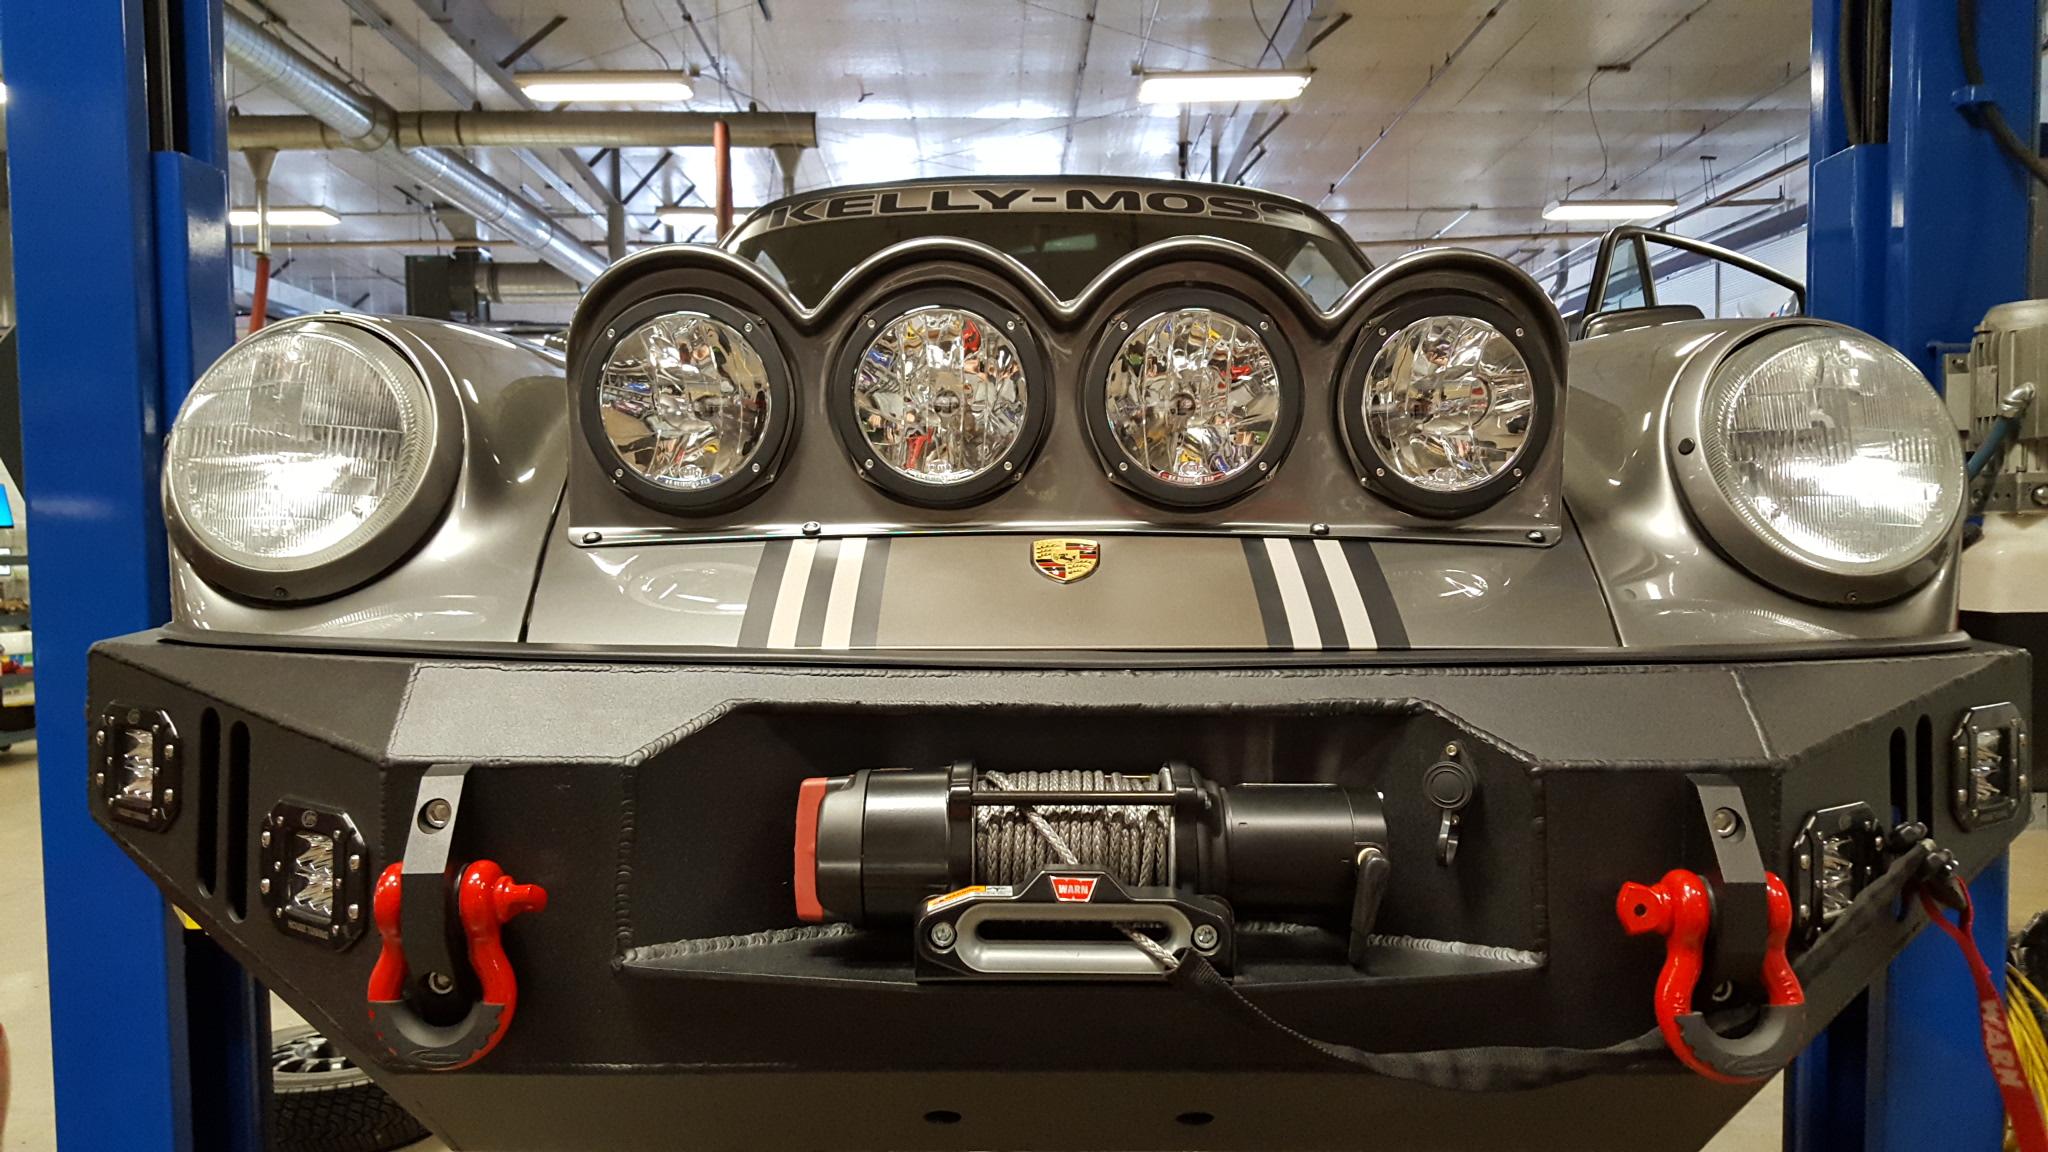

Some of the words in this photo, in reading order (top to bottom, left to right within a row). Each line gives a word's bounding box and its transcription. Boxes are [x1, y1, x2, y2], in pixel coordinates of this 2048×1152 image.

[767, 188, 1312, 231] KELLY-MOSS
[1058, 884, 1089, 895] WARN
[1980, 1000, 2024, 1088] WARN
